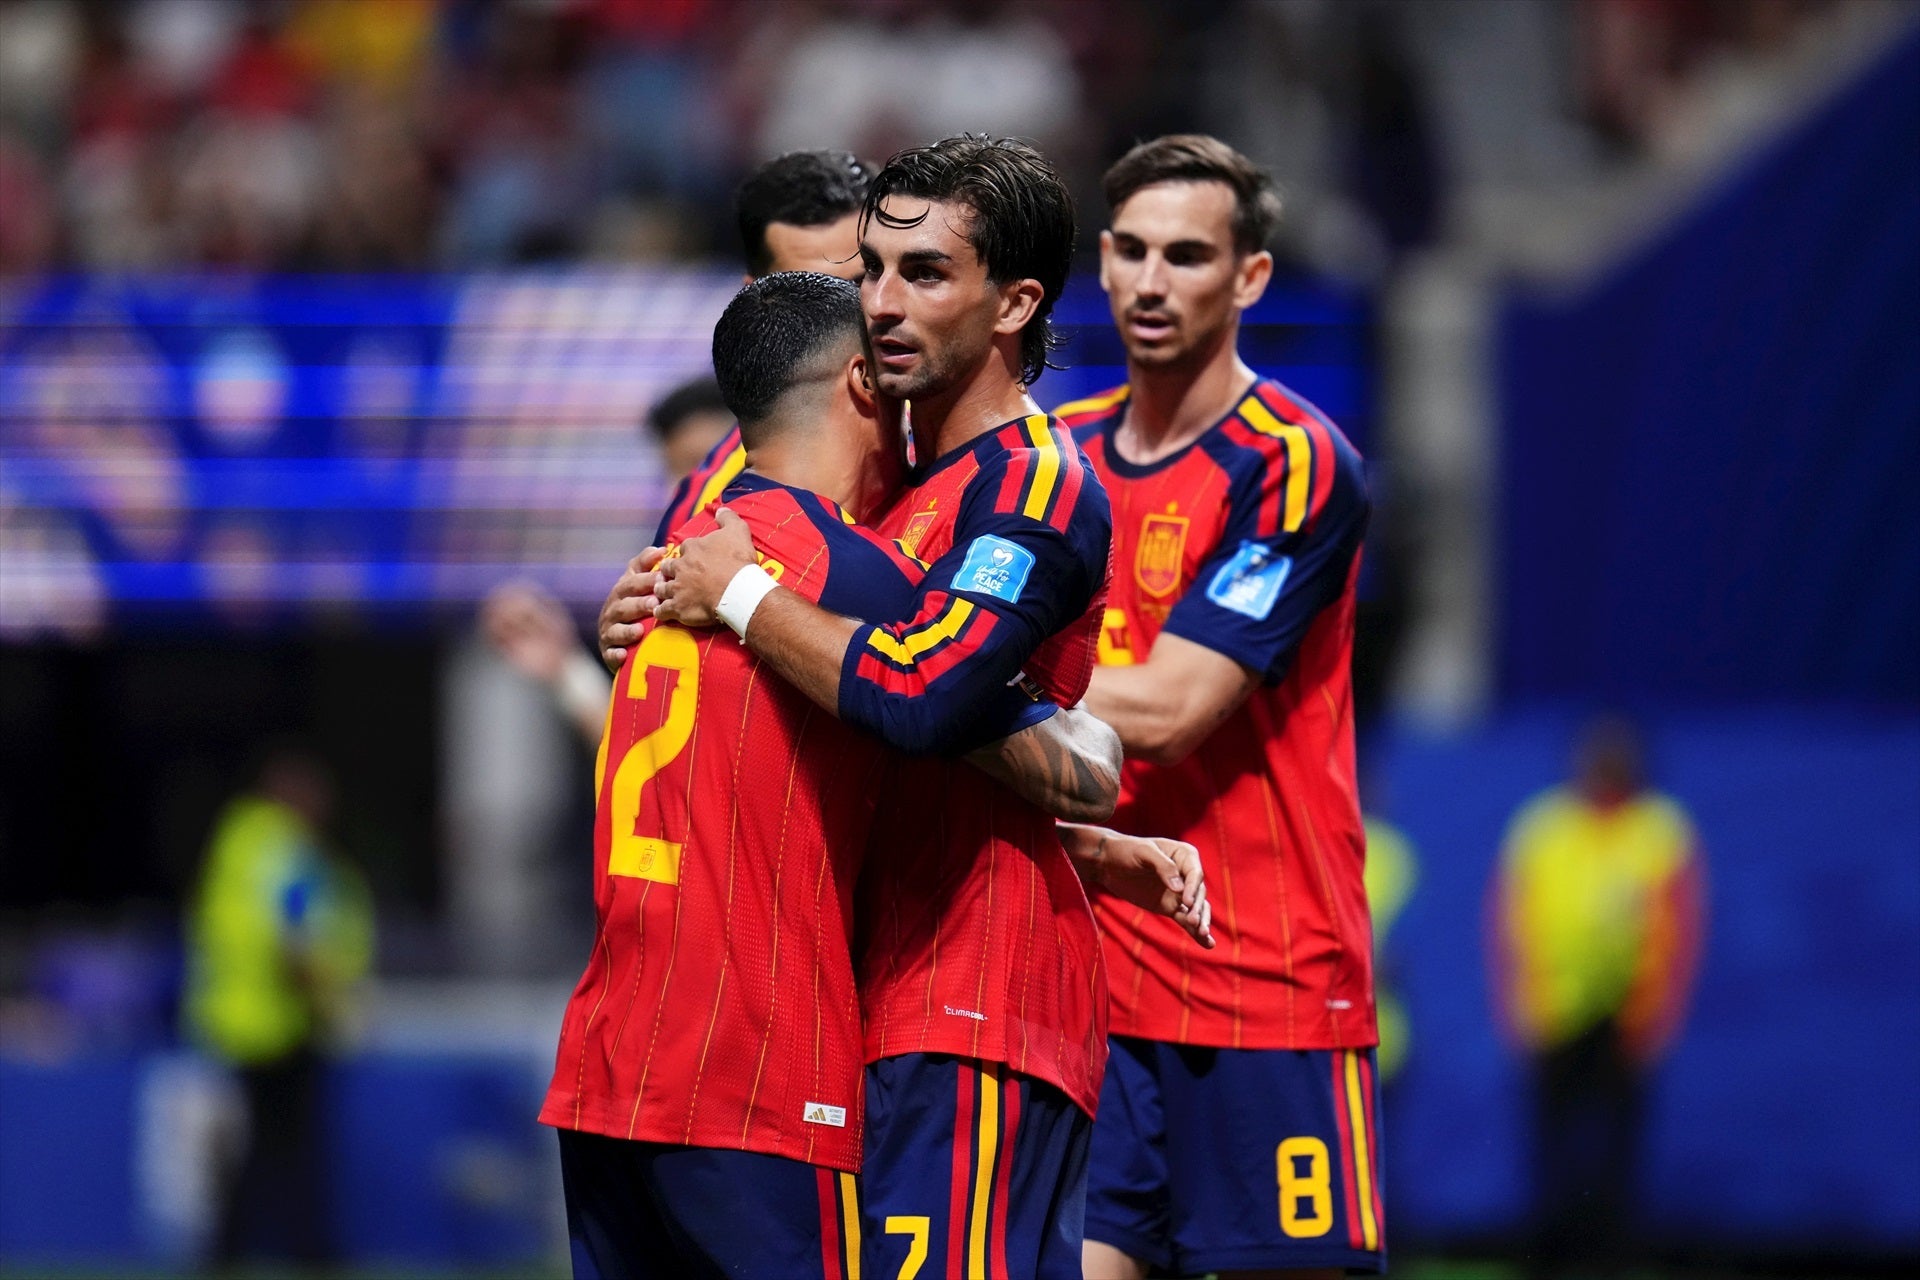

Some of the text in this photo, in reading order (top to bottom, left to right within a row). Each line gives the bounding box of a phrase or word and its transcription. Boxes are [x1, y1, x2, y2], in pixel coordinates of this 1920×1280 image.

[973, 572, 1004, 592] PEACE
[1276, 1136, 1333, 1238] 8
[885, 1216, 930, 1280] 7
